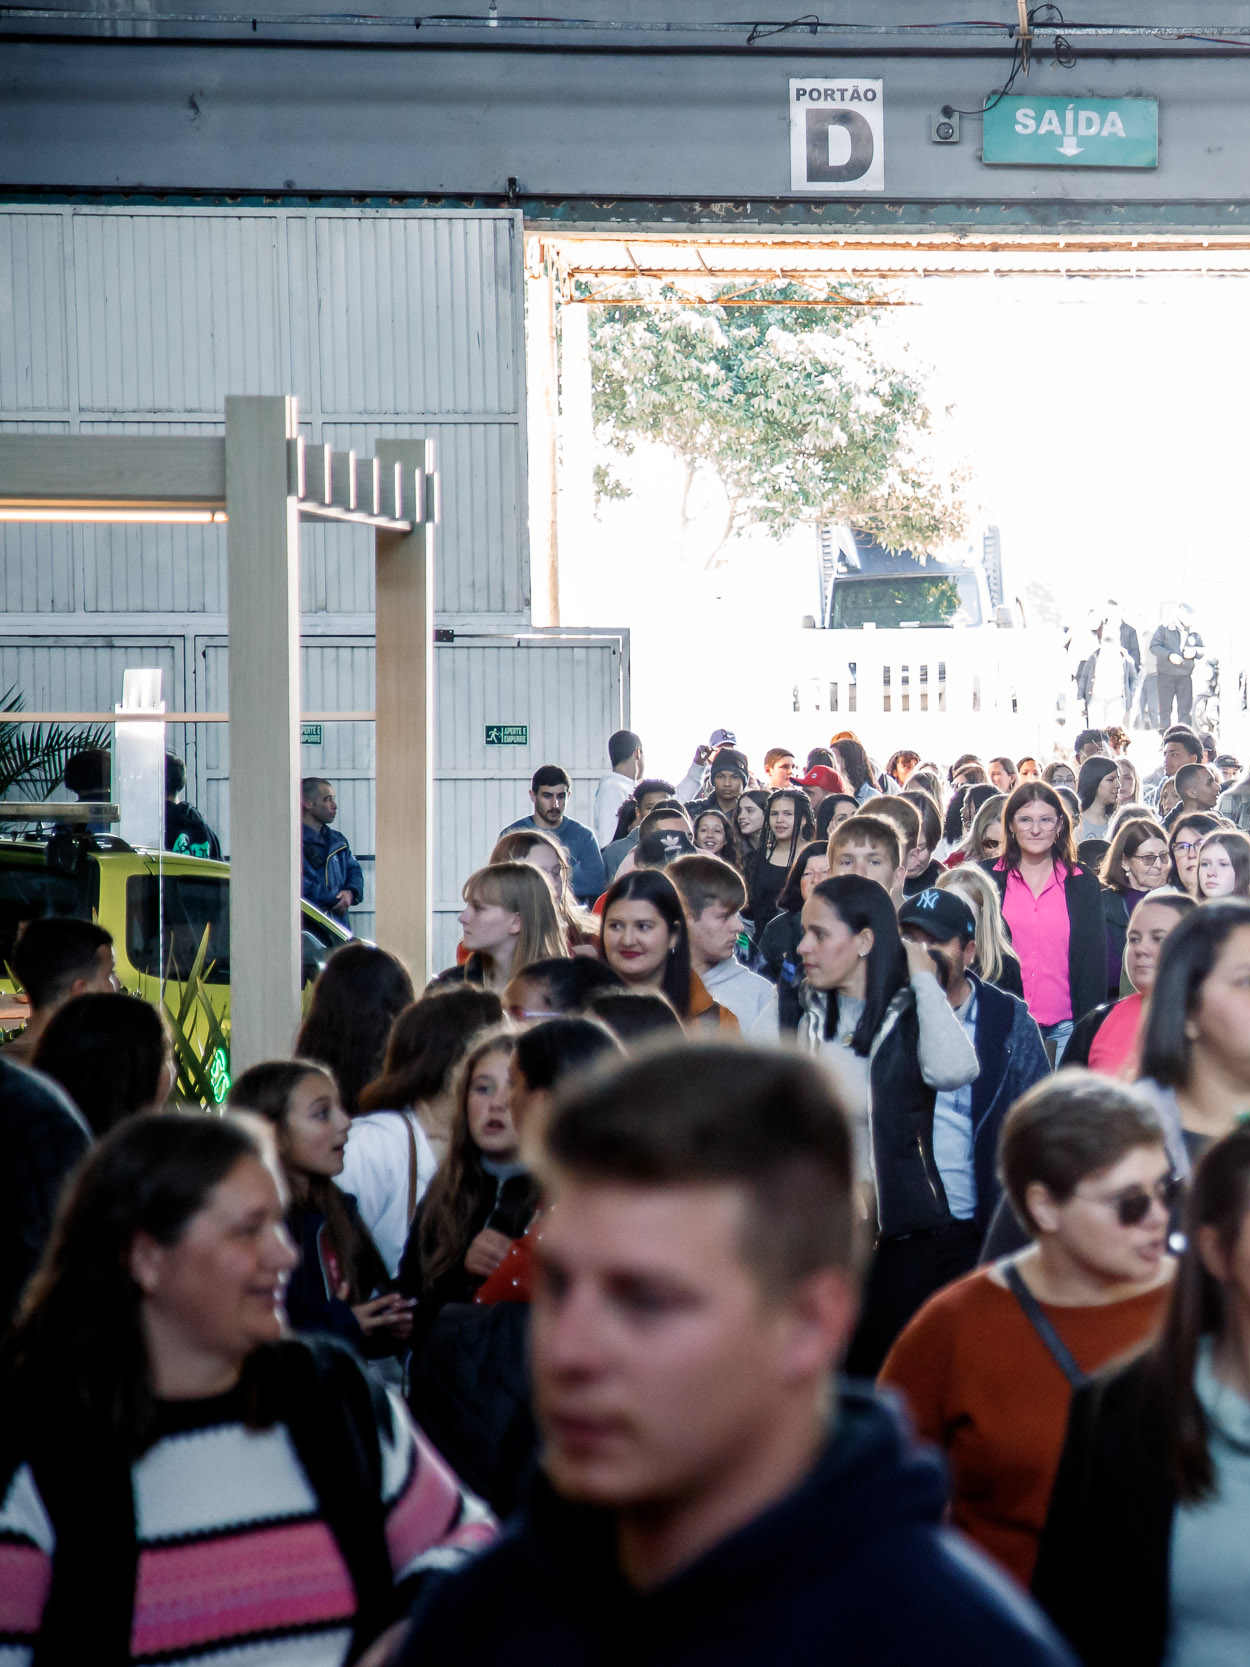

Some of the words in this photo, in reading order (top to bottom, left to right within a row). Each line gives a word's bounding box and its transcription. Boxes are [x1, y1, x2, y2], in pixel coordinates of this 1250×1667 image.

[795, 85, 877, 102] PORTÃO
[1014, 104, 1127, 137] SAÍDA
[805, 108, 874, 183] D
